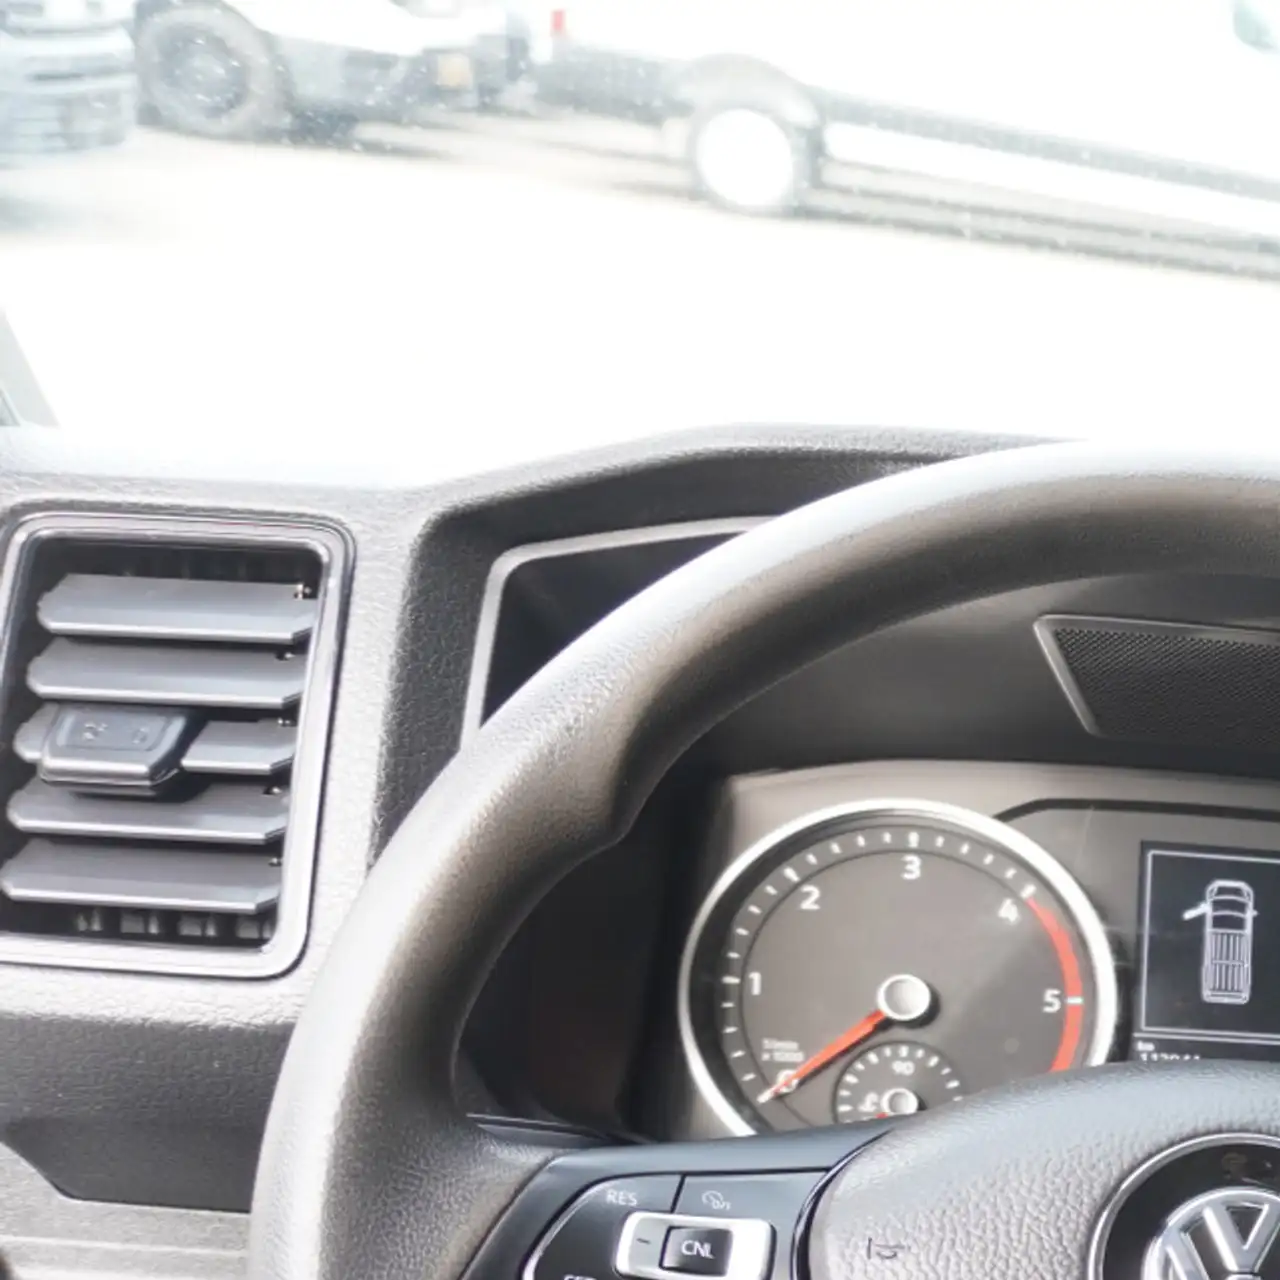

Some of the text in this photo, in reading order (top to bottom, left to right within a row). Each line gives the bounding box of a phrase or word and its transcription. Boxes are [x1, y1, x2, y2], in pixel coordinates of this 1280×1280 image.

[902, 856, 922, 880] 3
[800, 886, 820, 910] 2
[998, 899, 1019, 923] 4
[748, 971, 762, 995] 1
[1043, 989, 1062, 1013] 5
[605, 1188, 637, 1206] RES
[681, 1240, 714, 1259] CNL
